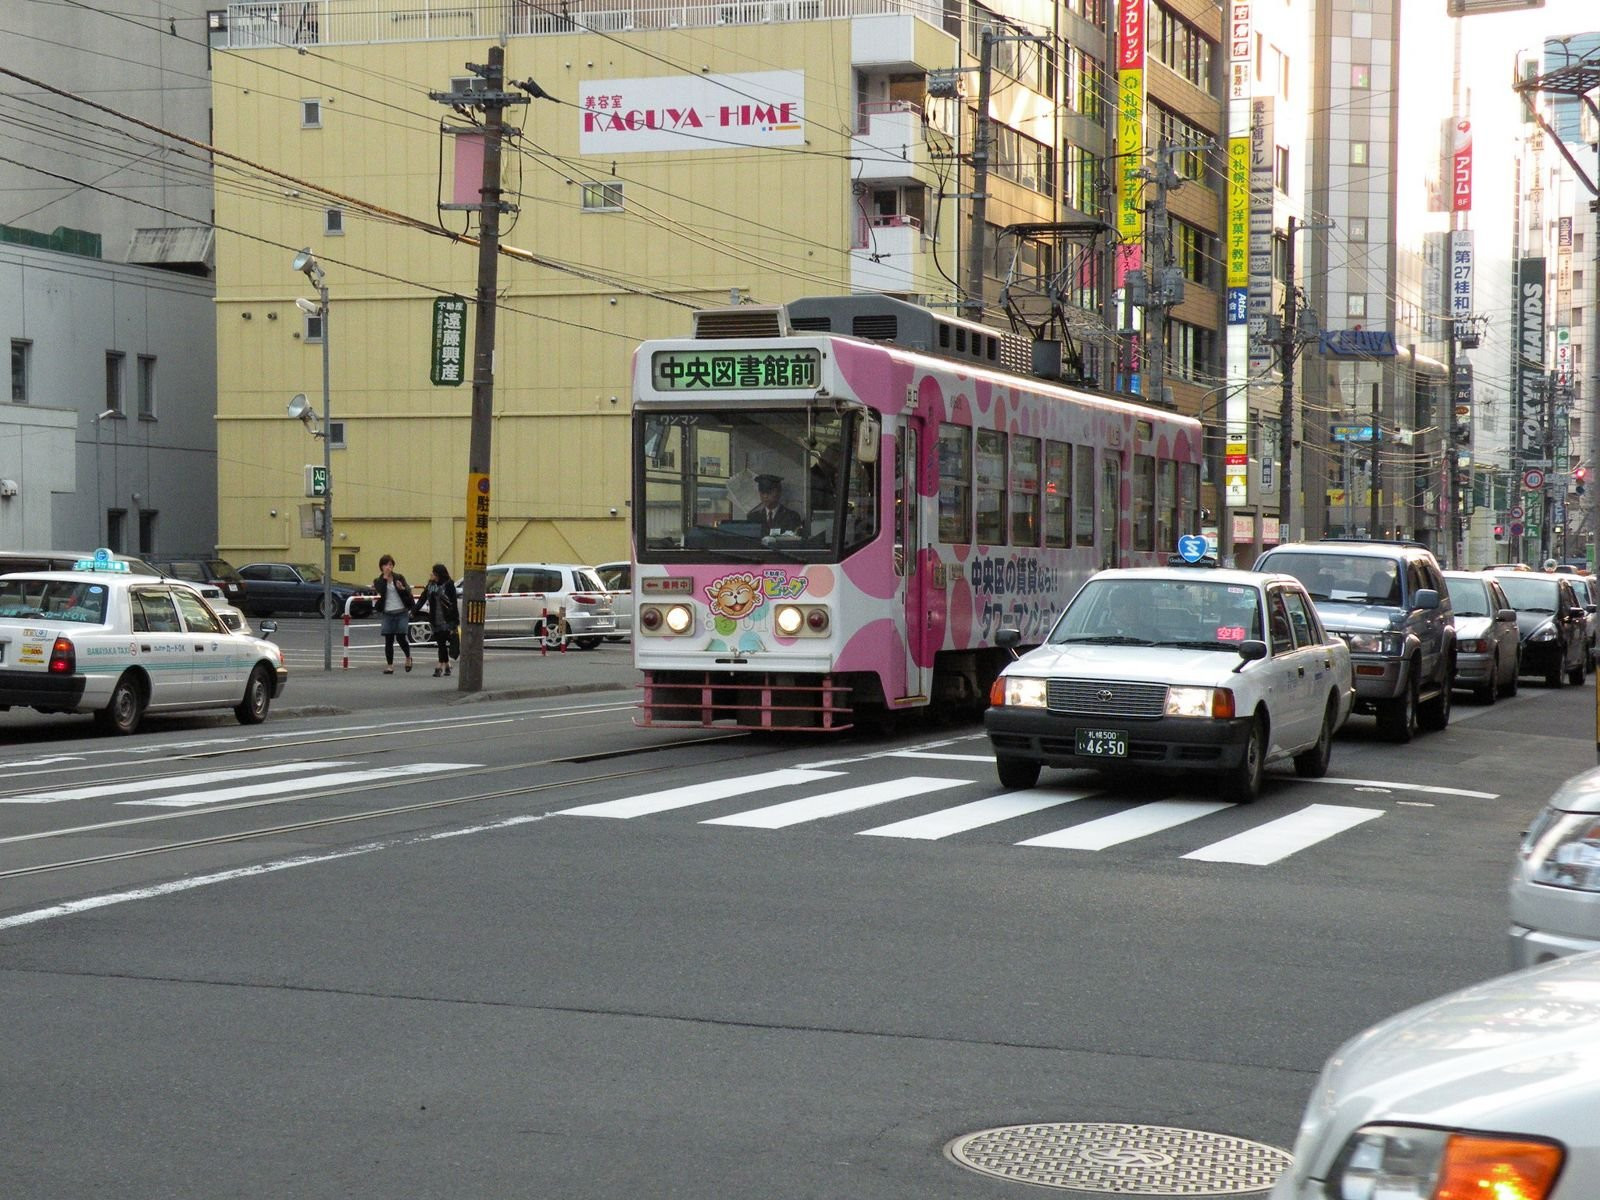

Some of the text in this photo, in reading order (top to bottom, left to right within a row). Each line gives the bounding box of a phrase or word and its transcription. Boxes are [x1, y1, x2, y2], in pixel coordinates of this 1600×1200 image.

[585, 95, 622, 109] 美容室
[1456, 156, 1470, 194] アコム
[1457, 198, 1468, 206] 8F
[1231, 160, 1245, 272] 札幌パン洋菓子教室
[438, 302, 463, 310] 不動産
[1521, 283, 1543, 362] HANDS
[441, 312, 461, 380] 遠藤興産
[660, 354, 816, 388] 中央図書館前
[1455, 391, 1469, 399] BC
[660, 416, 699, 425] ワンマン
[315, 470, 326, 481] 入口
[475, 495, 490, 566] 駐車禁止
[972, 556, 1058, 595] 中央区の賃貸なら!!
[763, 577, 807, 597] ビッグ
[703, 612, 768, 633] 801
[1217, 627, 1245, 641] 空車
[1103, 731, 1117, 740] 500
[1086, 739, 1125, 755] 46-50
